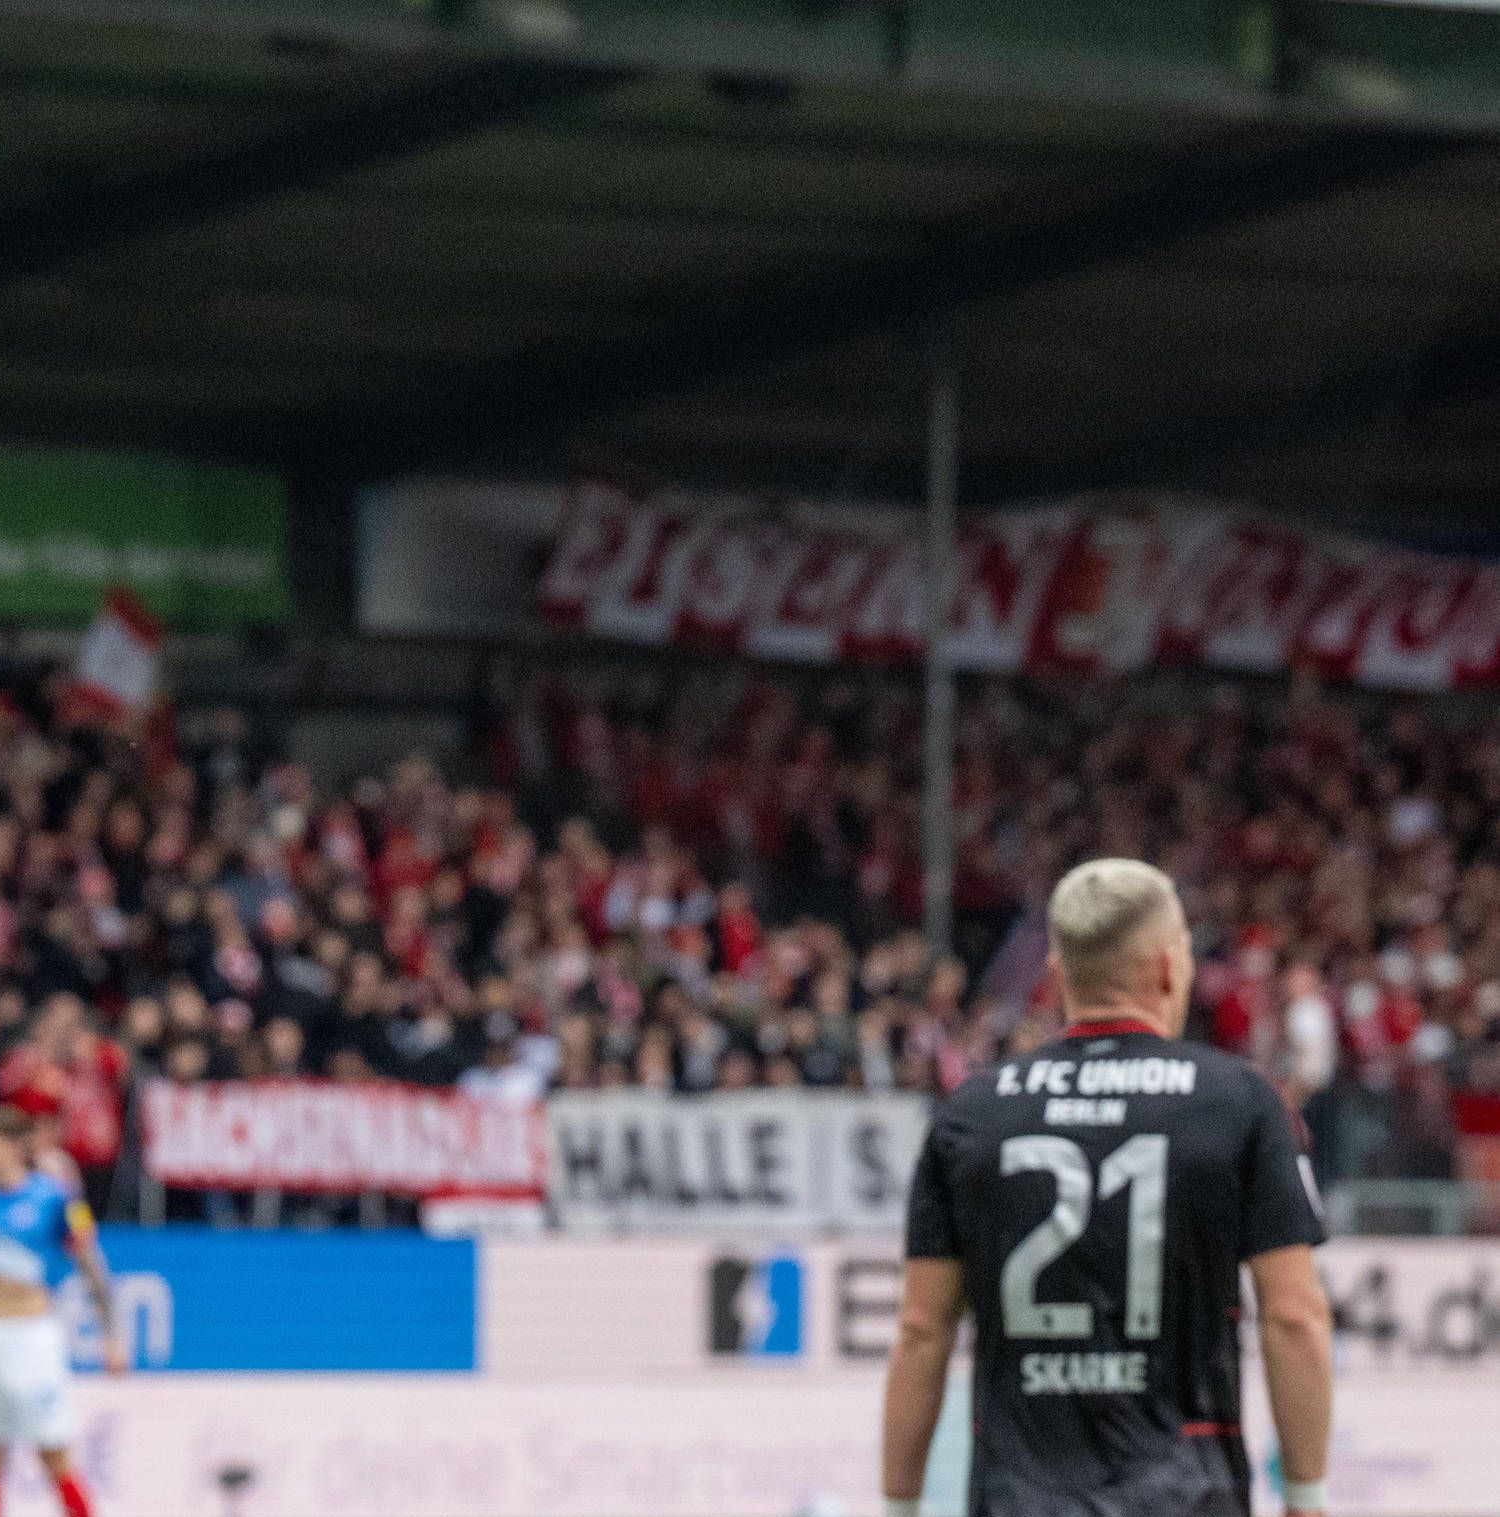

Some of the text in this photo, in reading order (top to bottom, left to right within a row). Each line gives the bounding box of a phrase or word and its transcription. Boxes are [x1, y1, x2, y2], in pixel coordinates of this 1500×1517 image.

[1025, 1059, 1078, 1096] FC
[1077, 1056, 1198, 1096] UNION
[1000, 1132, 1170, 1341] 21
